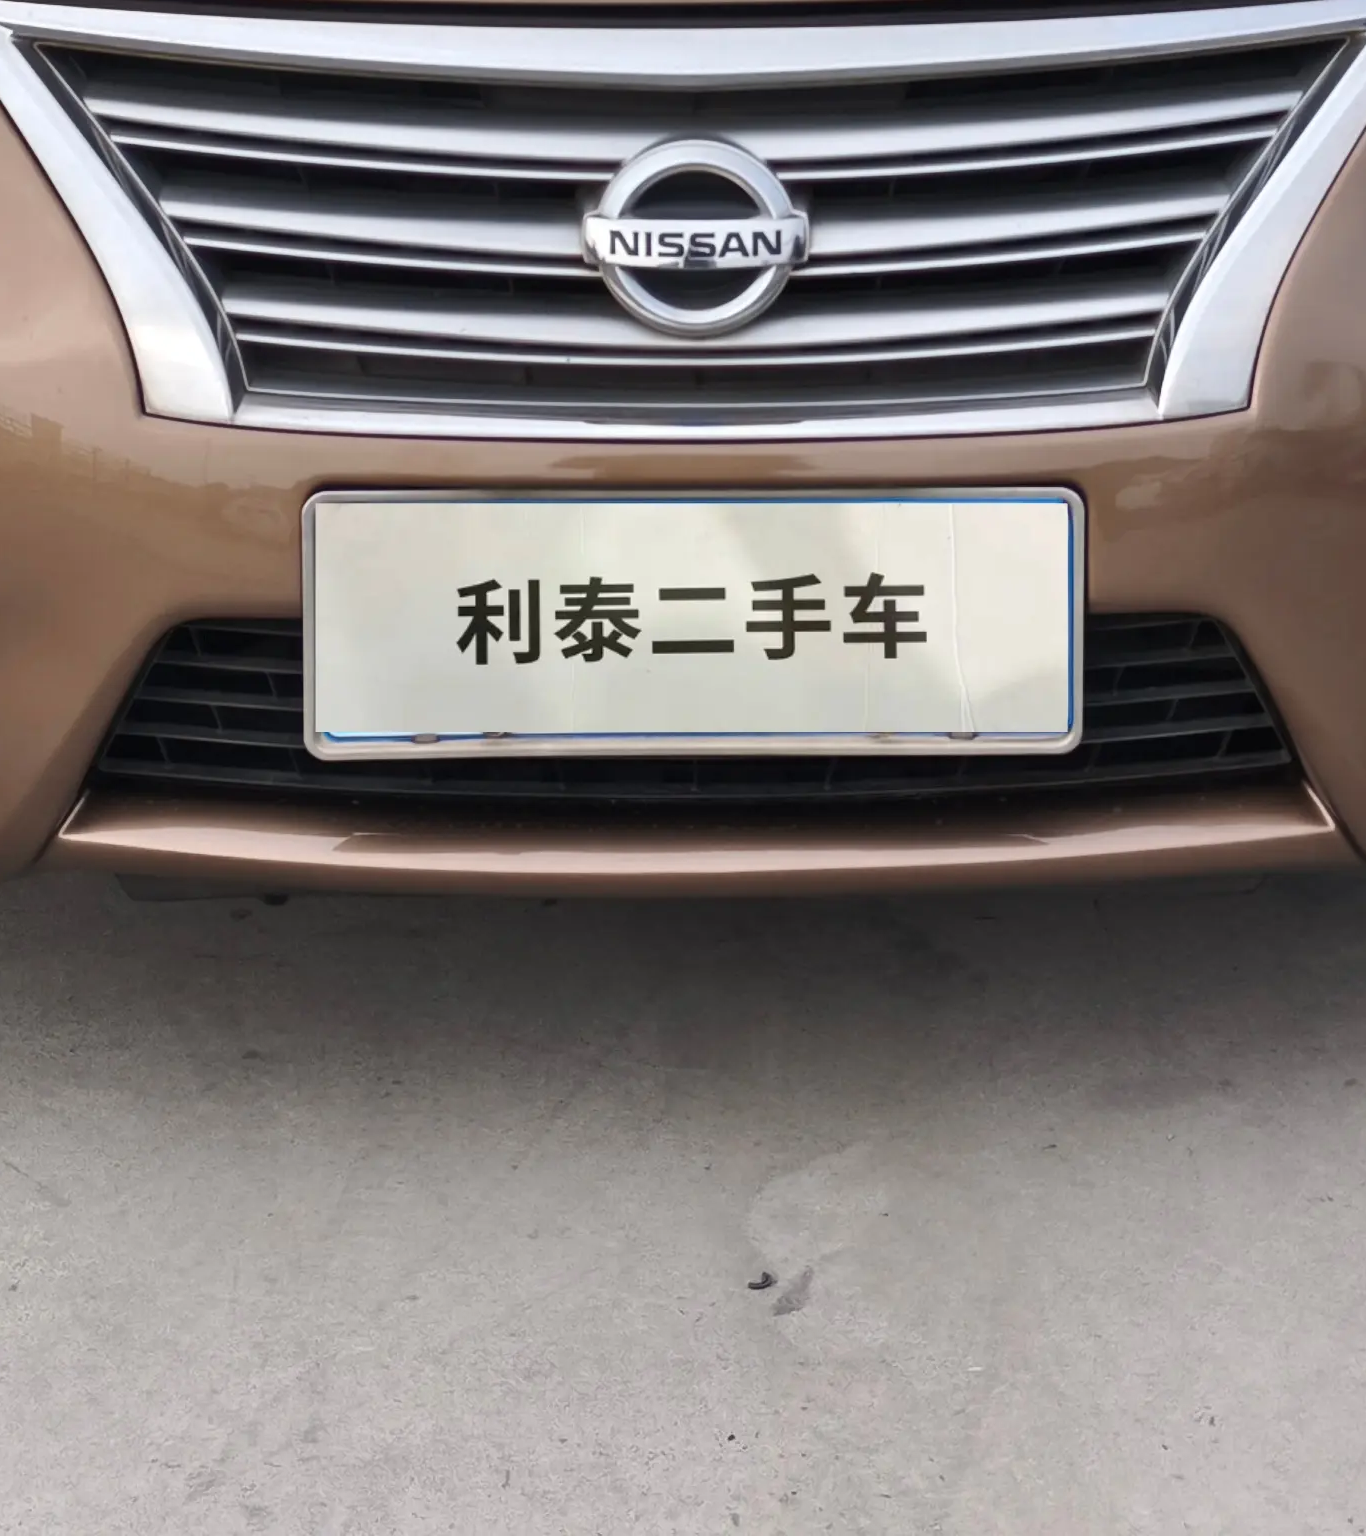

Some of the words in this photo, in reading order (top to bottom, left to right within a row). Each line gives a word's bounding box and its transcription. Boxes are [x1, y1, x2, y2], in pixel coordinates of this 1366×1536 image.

[609, 229, 782, 259] NISSAN
[455, 572, 929, 666] 利泰二手车
